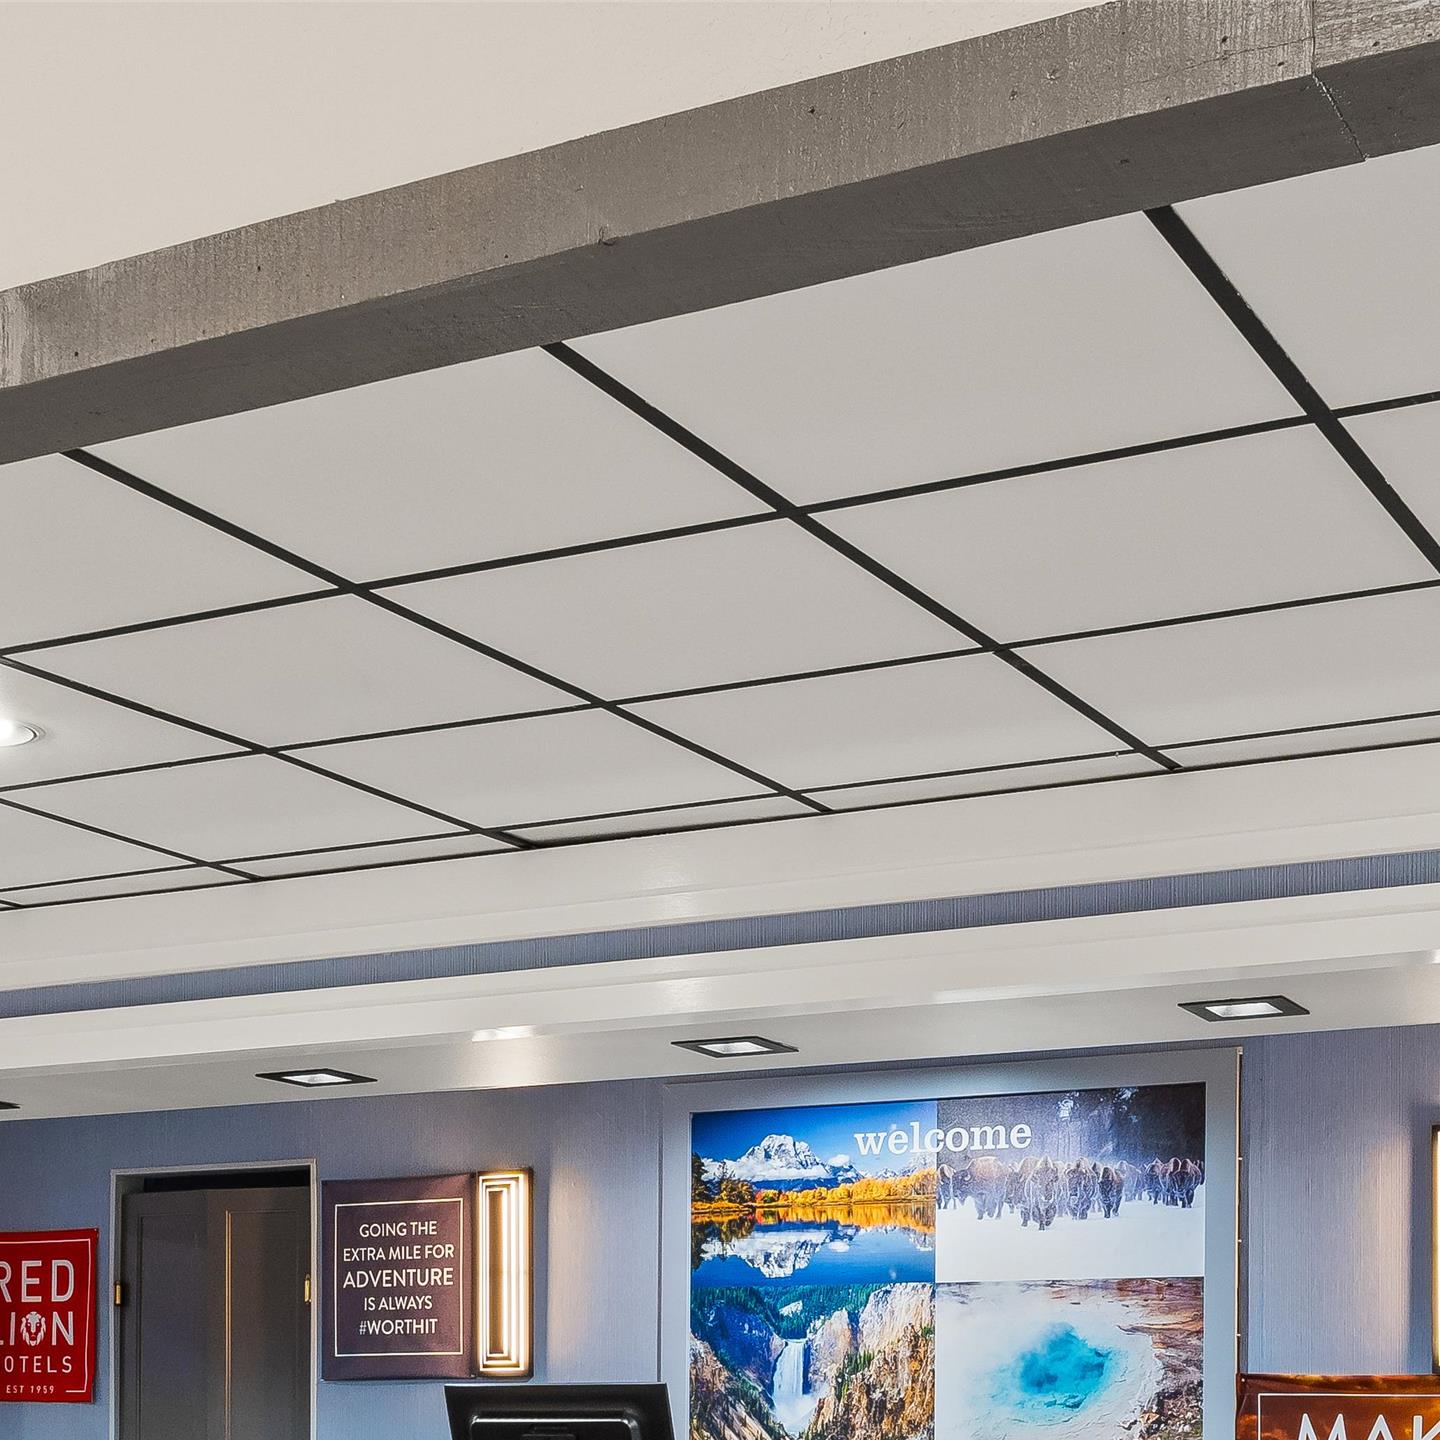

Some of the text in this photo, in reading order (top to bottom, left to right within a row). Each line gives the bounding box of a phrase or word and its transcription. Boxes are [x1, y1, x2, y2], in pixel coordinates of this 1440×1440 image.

[854, 1121, 1032, 1156] welcome
[359, 1220, 438, 1238] GOING THE
[343, 1244, 455, 1262] EXTRA MILE FOR
[343, 1268, 454, 1289] ADVENTURE
[364, 1295, 433, 1311] IS ALWAYS
[359, 1318, 438, 1335] #WORTHIT
[6, 1385, 55, 1394] EST 1959
